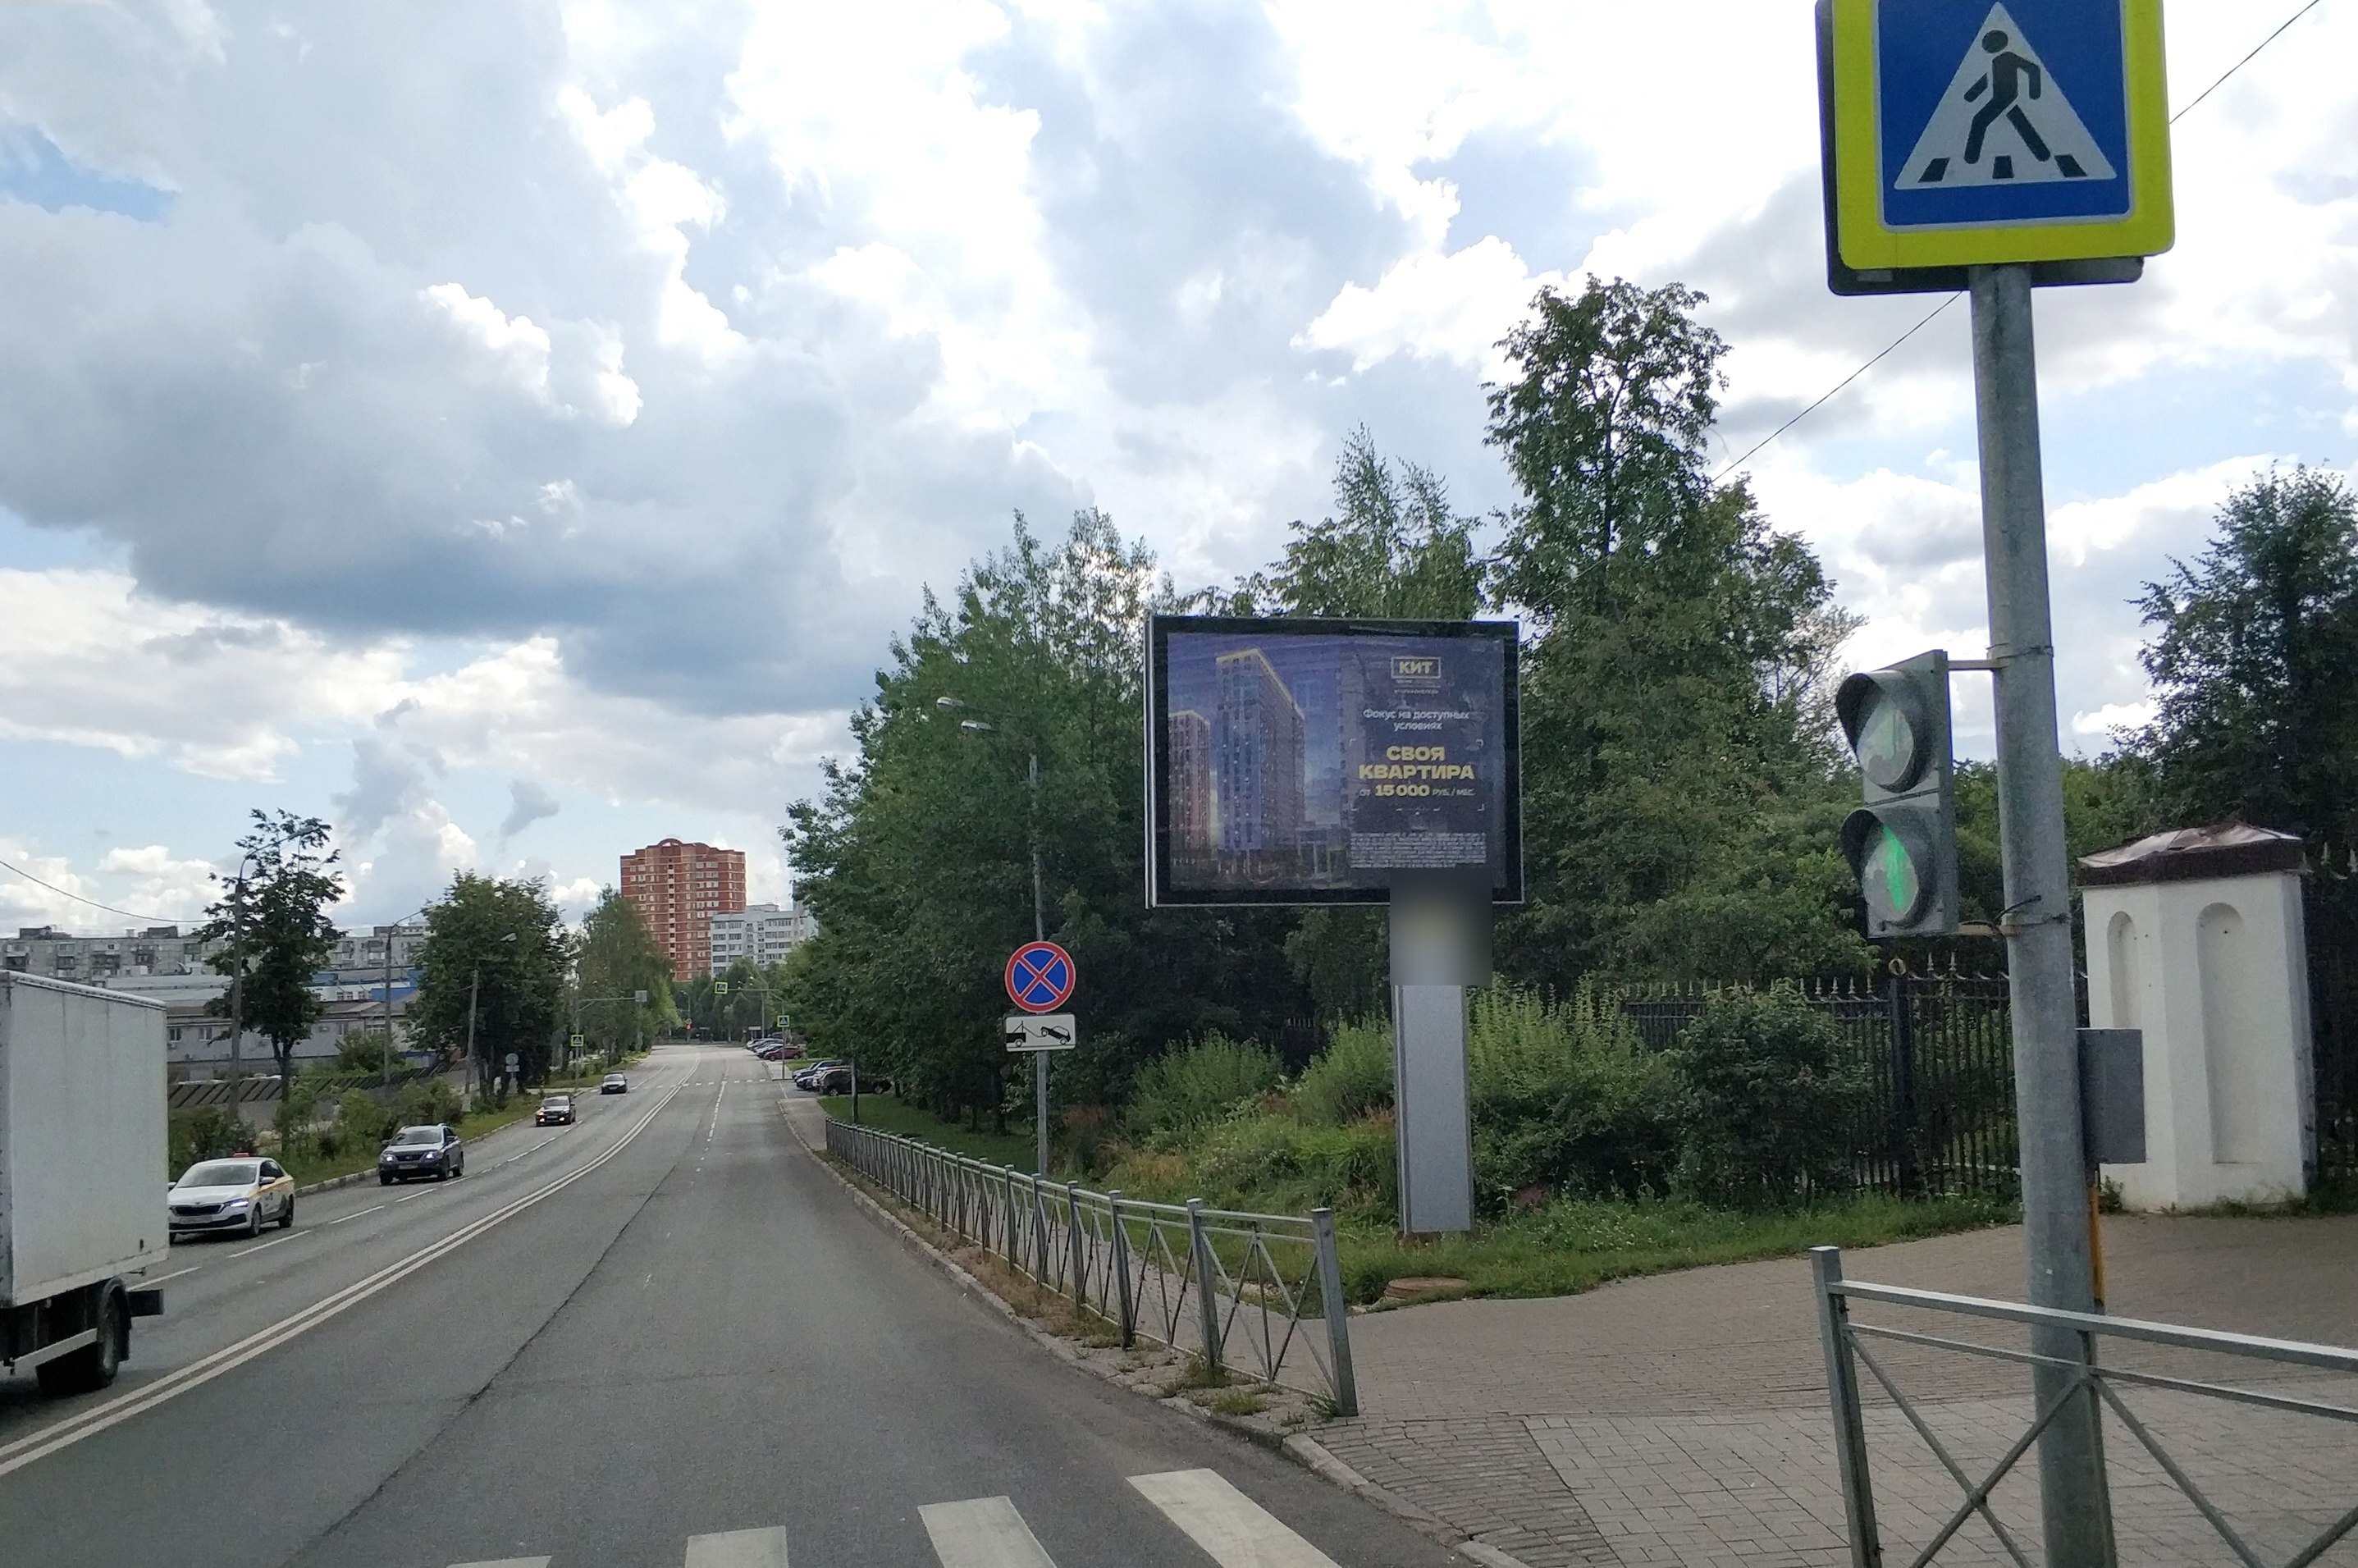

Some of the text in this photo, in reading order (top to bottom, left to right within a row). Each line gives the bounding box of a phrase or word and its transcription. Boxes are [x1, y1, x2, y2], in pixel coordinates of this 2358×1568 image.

[1399, 661, 1433, 674] КИТ
[1363, 708, 1396, 720] Фокус
[1413, 711, 1469, 721] доступных
[1394, 722, 1442, 732] условиях
[1387, 746, 1446, 761] СВОЯ
[1359, 765, 1475, 779] КВАРТИРА
